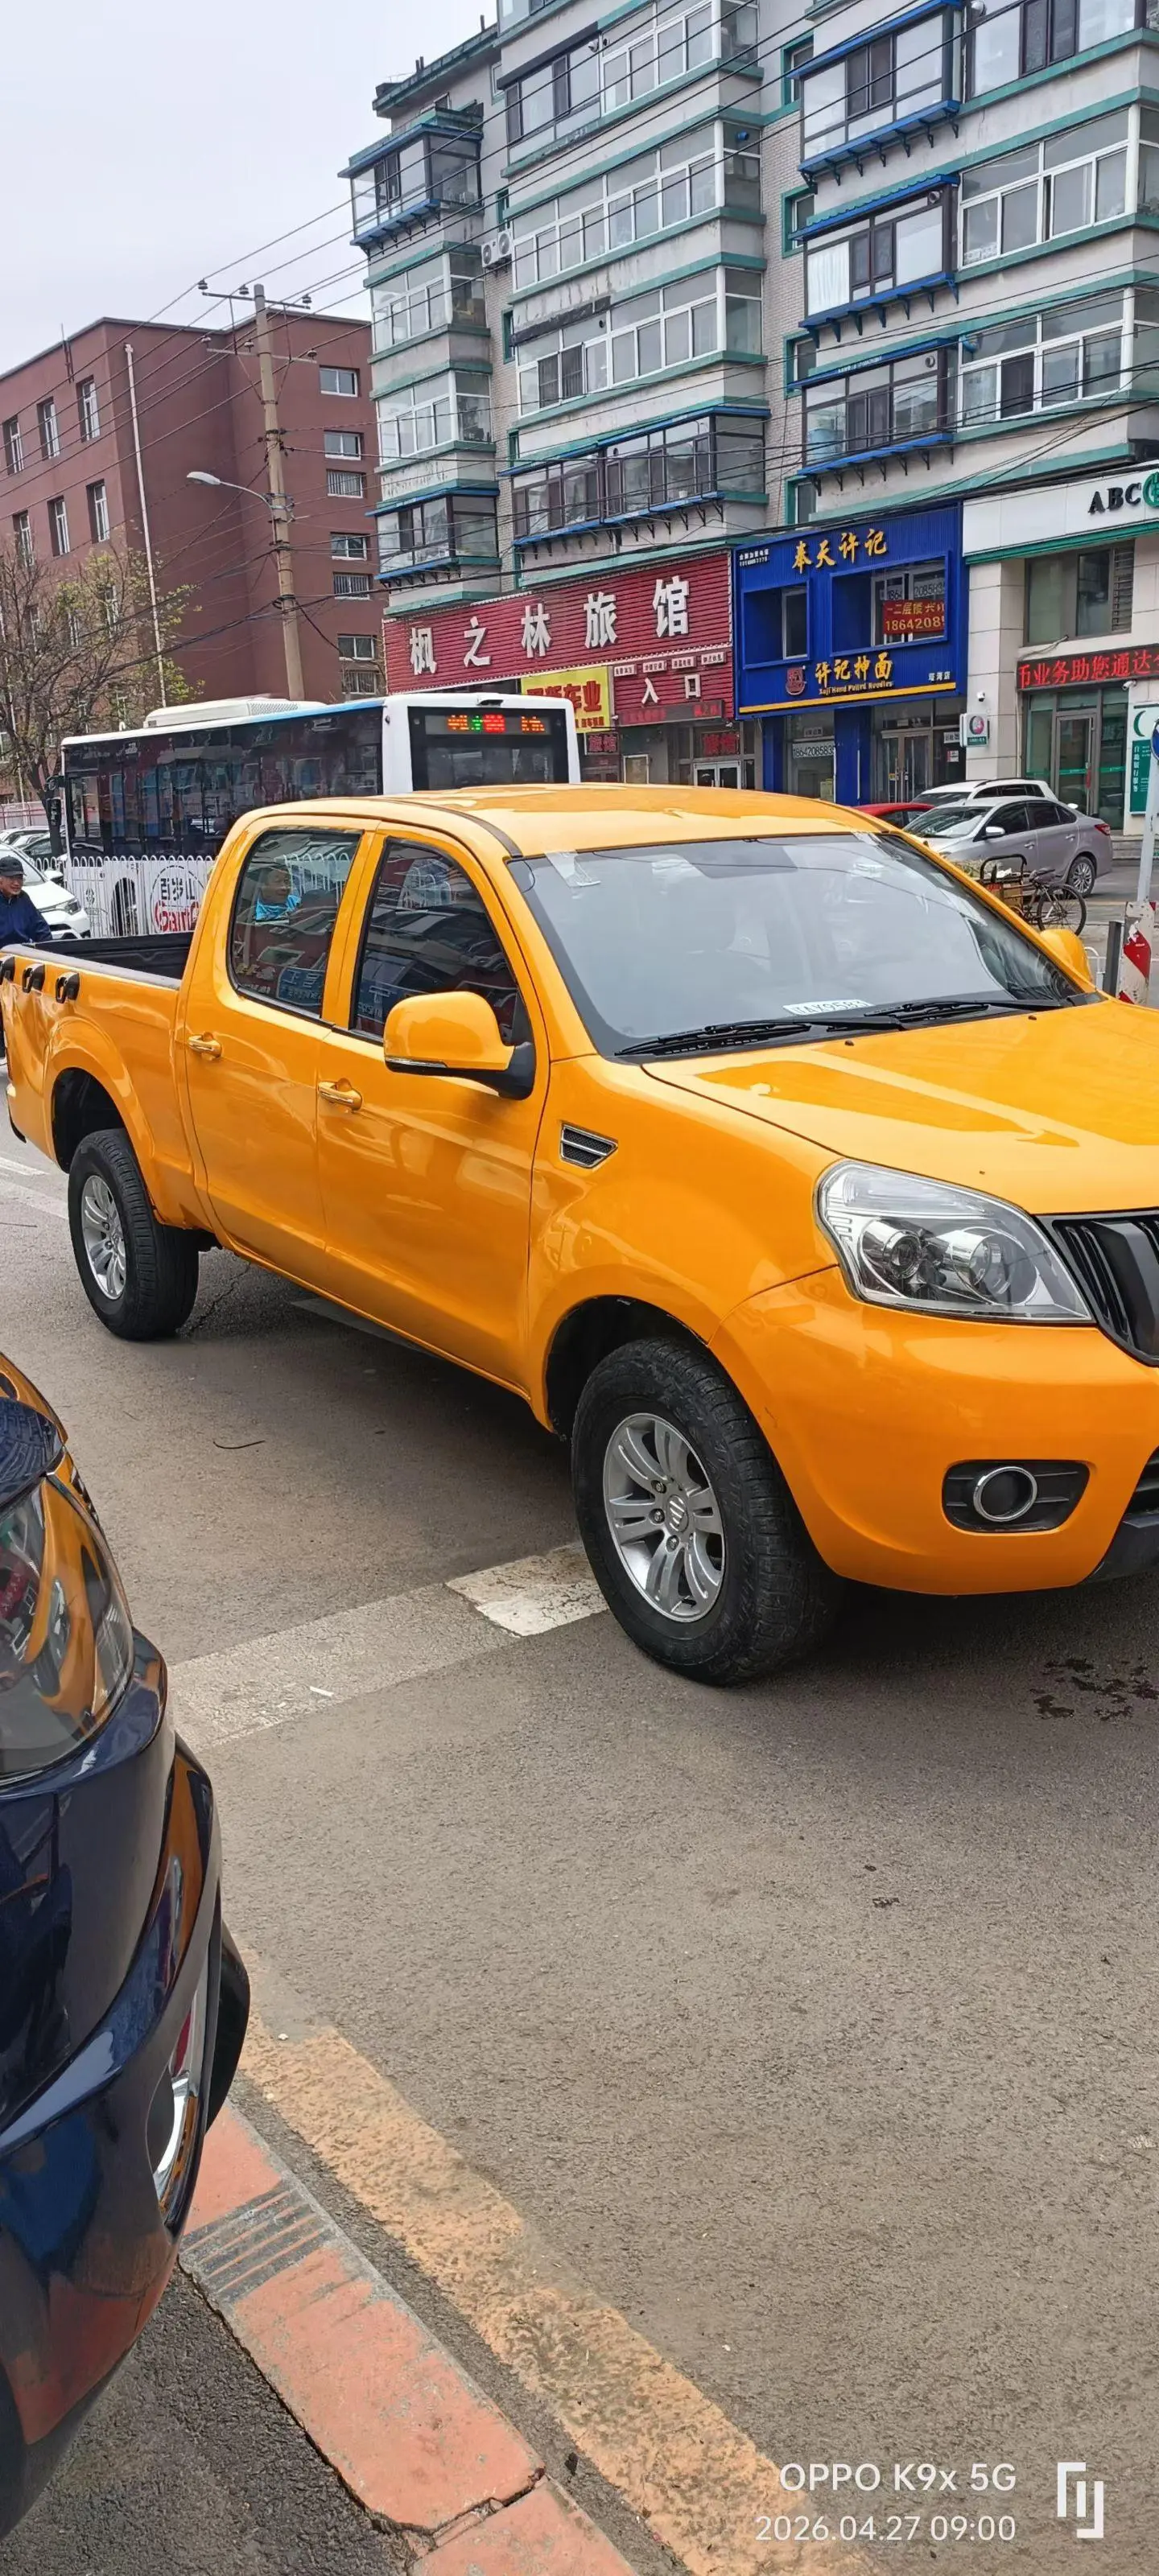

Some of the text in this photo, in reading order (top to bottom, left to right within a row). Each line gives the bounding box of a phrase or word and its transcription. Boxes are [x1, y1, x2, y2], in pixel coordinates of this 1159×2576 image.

[1087, 483, 1142, 514] ABC
[792, 529, 887, 574] 奉天许记
[409, 575, 690, 675] 枫之林旅馆
[641, 674, 702, 704] 入口
